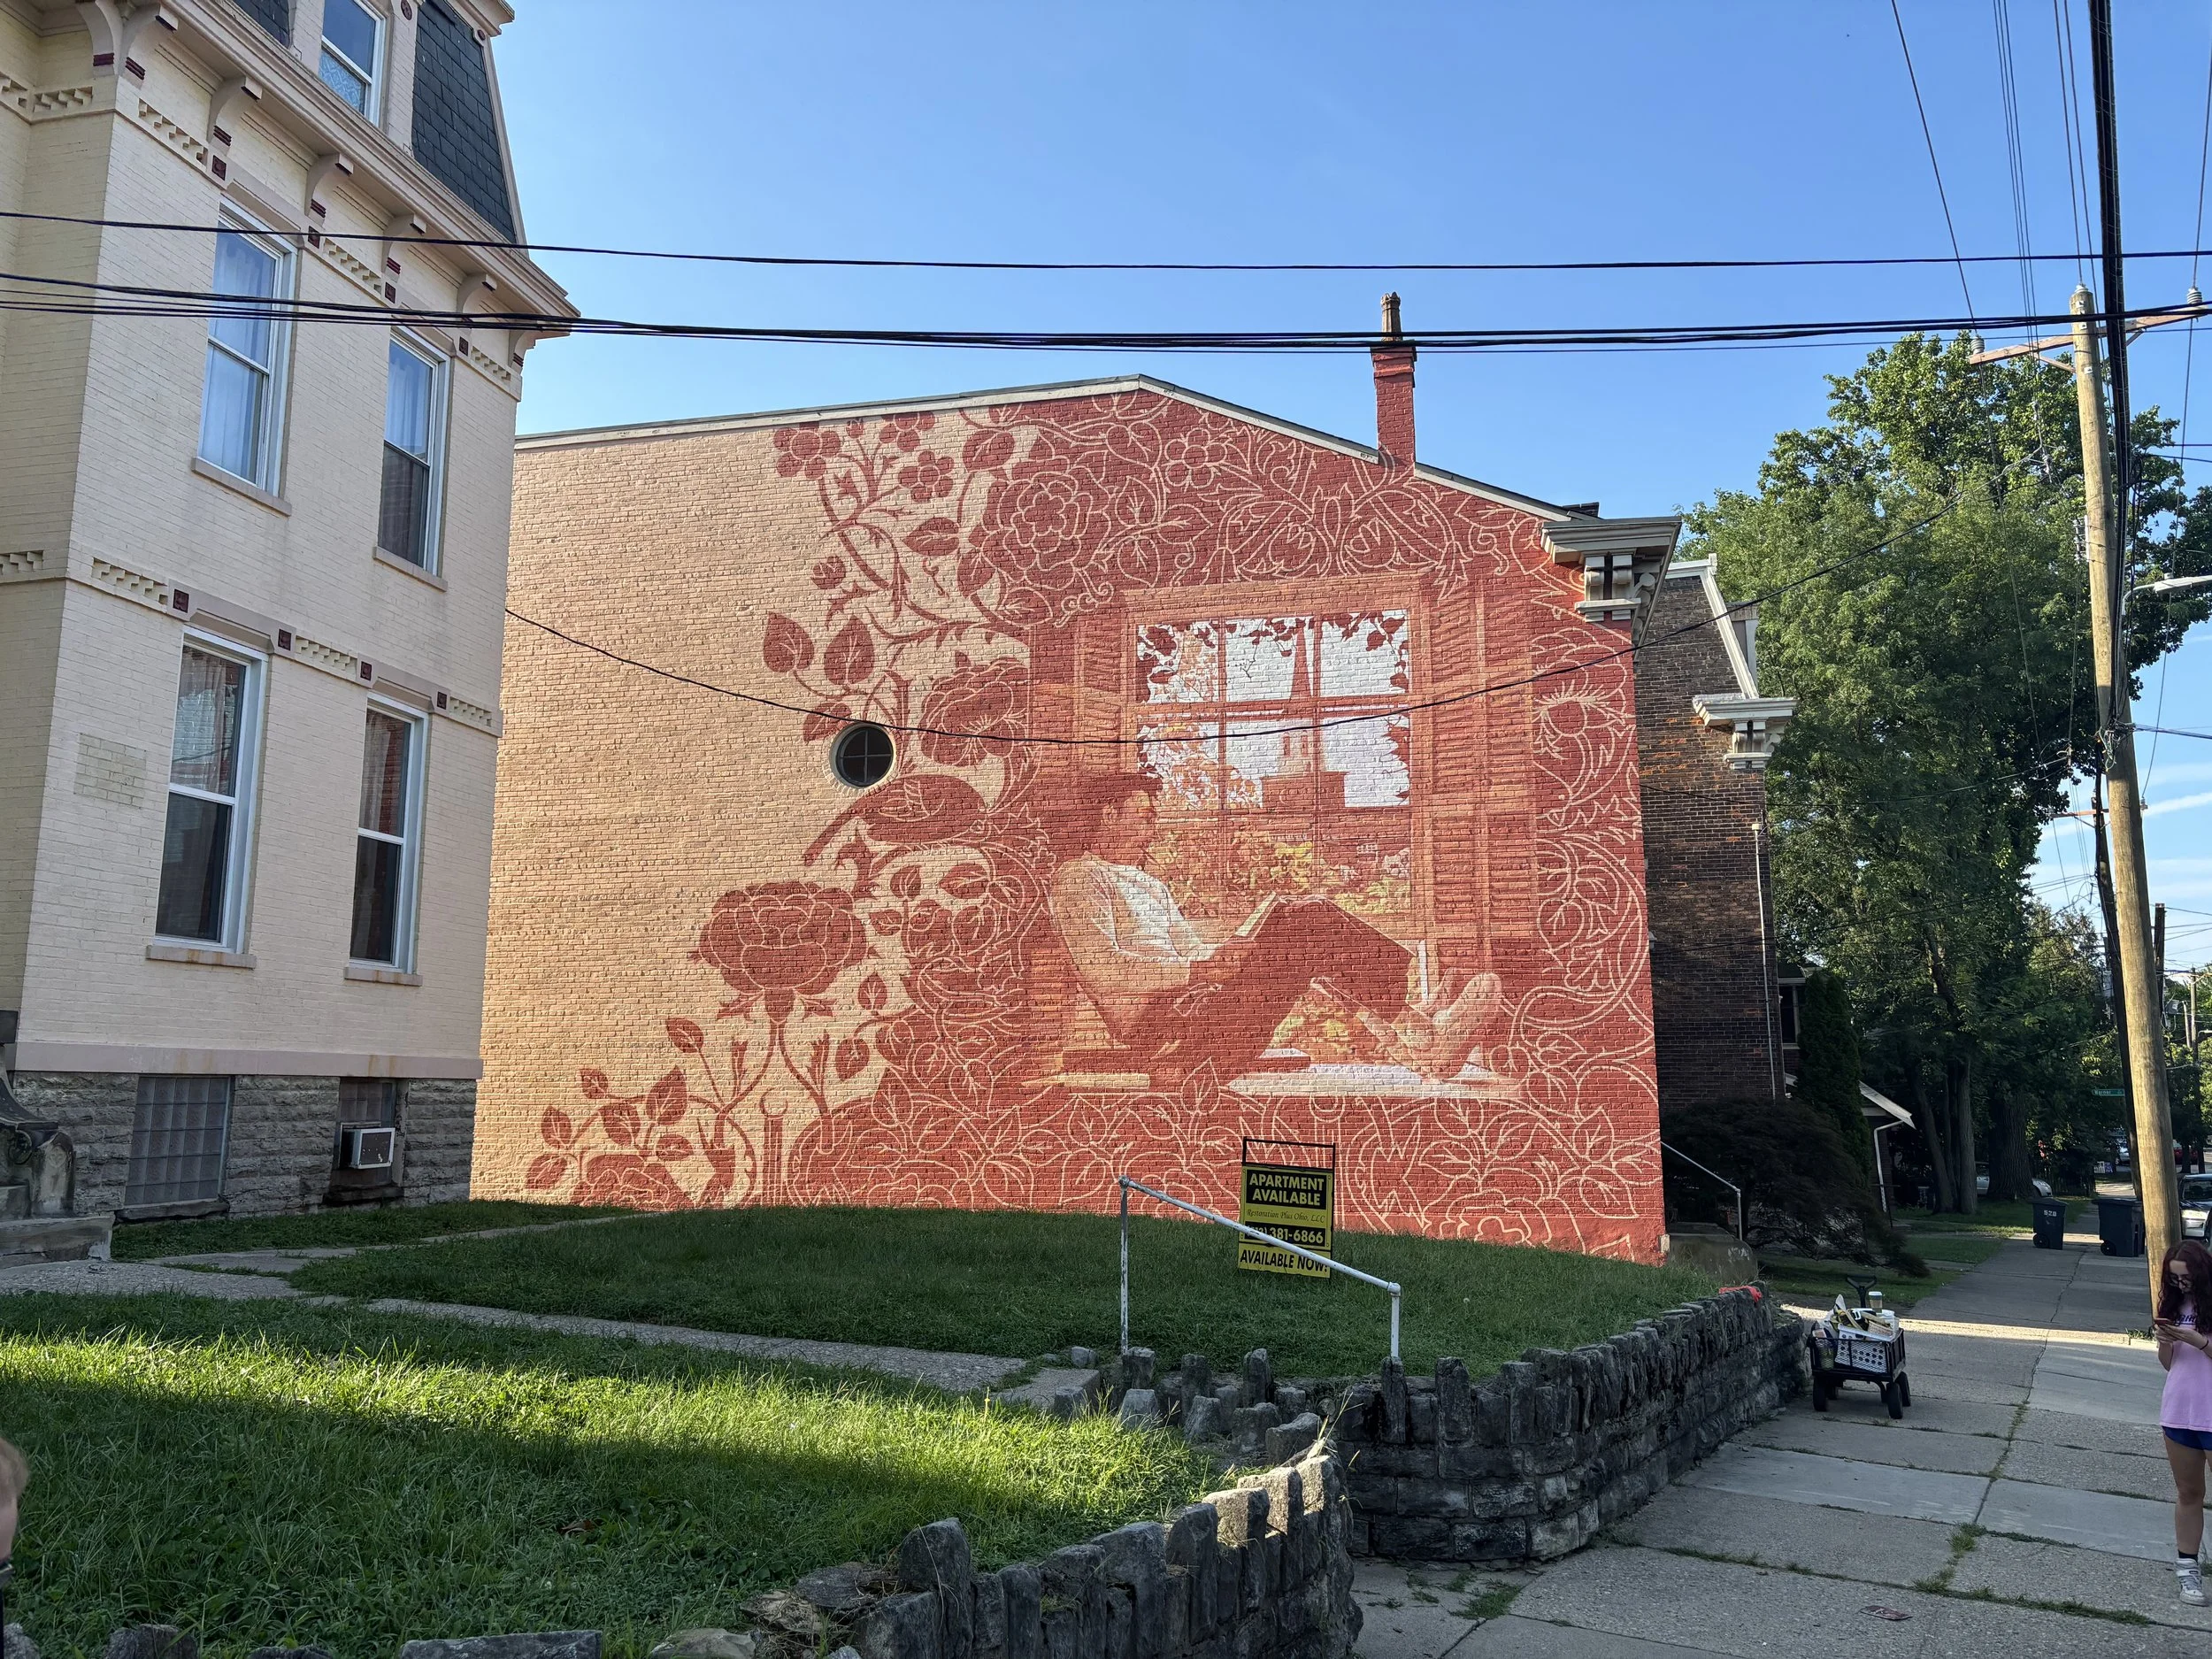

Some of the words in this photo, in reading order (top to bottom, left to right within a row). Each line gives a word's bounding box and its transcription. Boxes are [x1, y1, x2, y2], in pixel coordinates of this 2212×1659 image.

[1249, 1173, 1325, 1191] APARTMENT
[1252, 1187, 1321, 1206] AVAILABLE
[1246, 1209, 1279, 1219] Restoration
[1280, 1210, 1293, 1220] Plus
[1294, 1212, 1310, 1222] Ohio,
[1310, 1214, 1325, 1224] LLC
[1269, 1226, 1324, 1244] 381-6866
[1240, 1249, 1294, 1269] AVAILABLE
